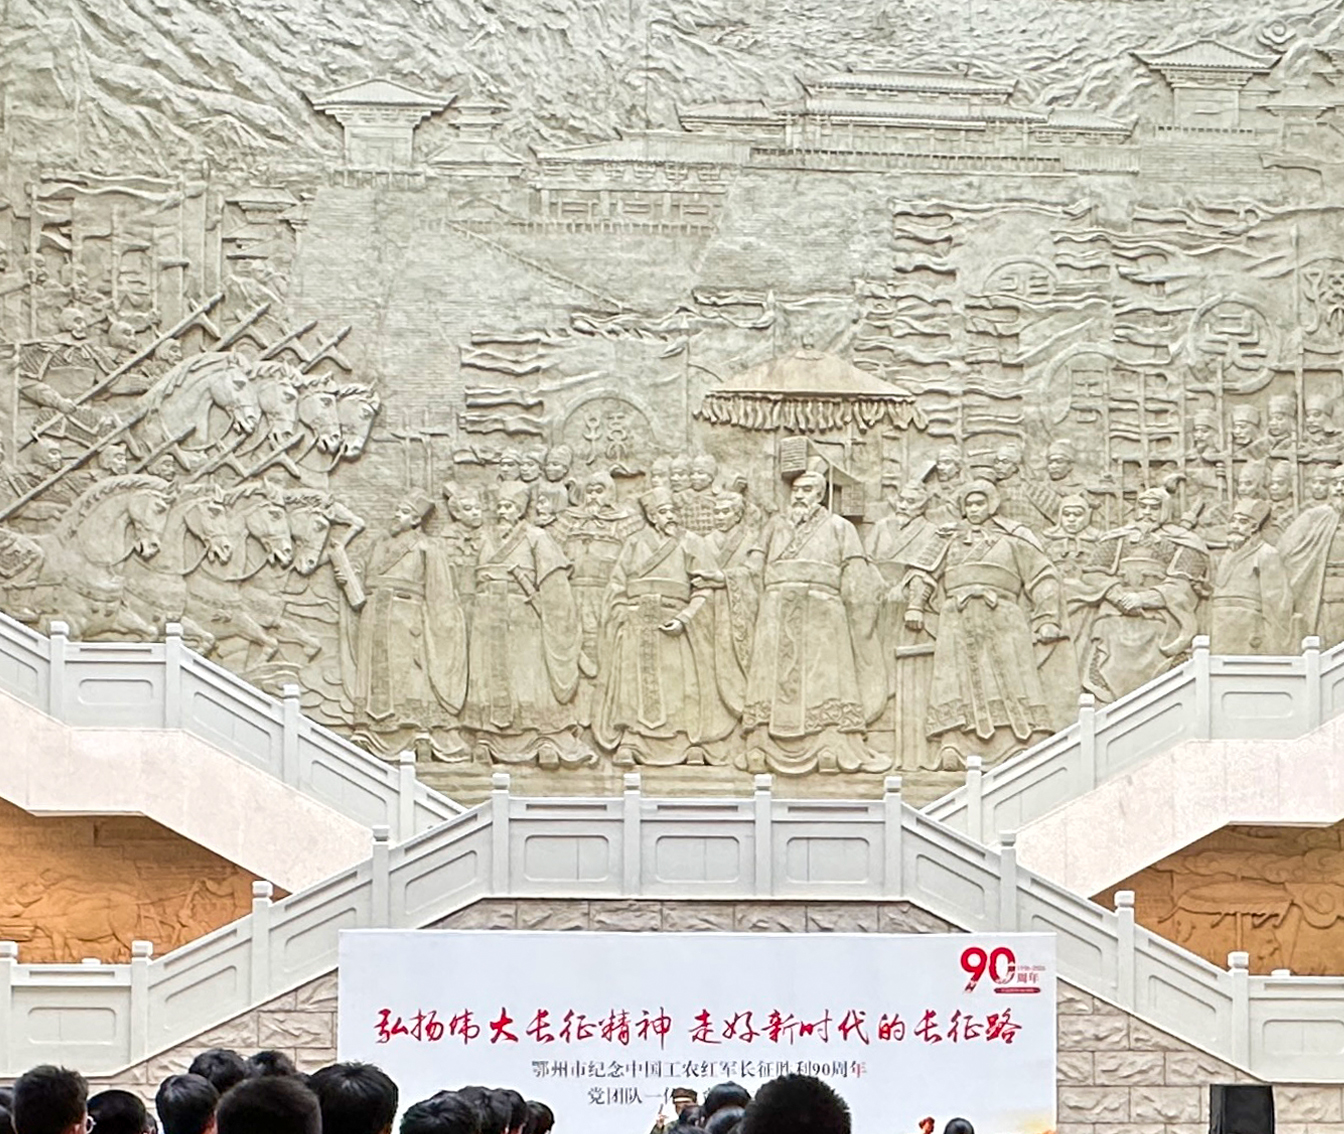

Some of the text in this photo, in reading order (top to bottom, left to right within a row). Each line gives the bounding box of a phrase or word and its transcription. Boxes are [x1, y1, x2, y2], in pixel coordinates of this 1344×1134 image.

[960, 946, 1016, 993] 90
[1017, 972, 1040, 984] 周年
[374, 1006, 1023, 1050] 弘扬伟大长征精神 走好新时代的长征路
[531, 1060, 867, 1078] 鄂州市纪念中国工农红军长征胜利90周年
